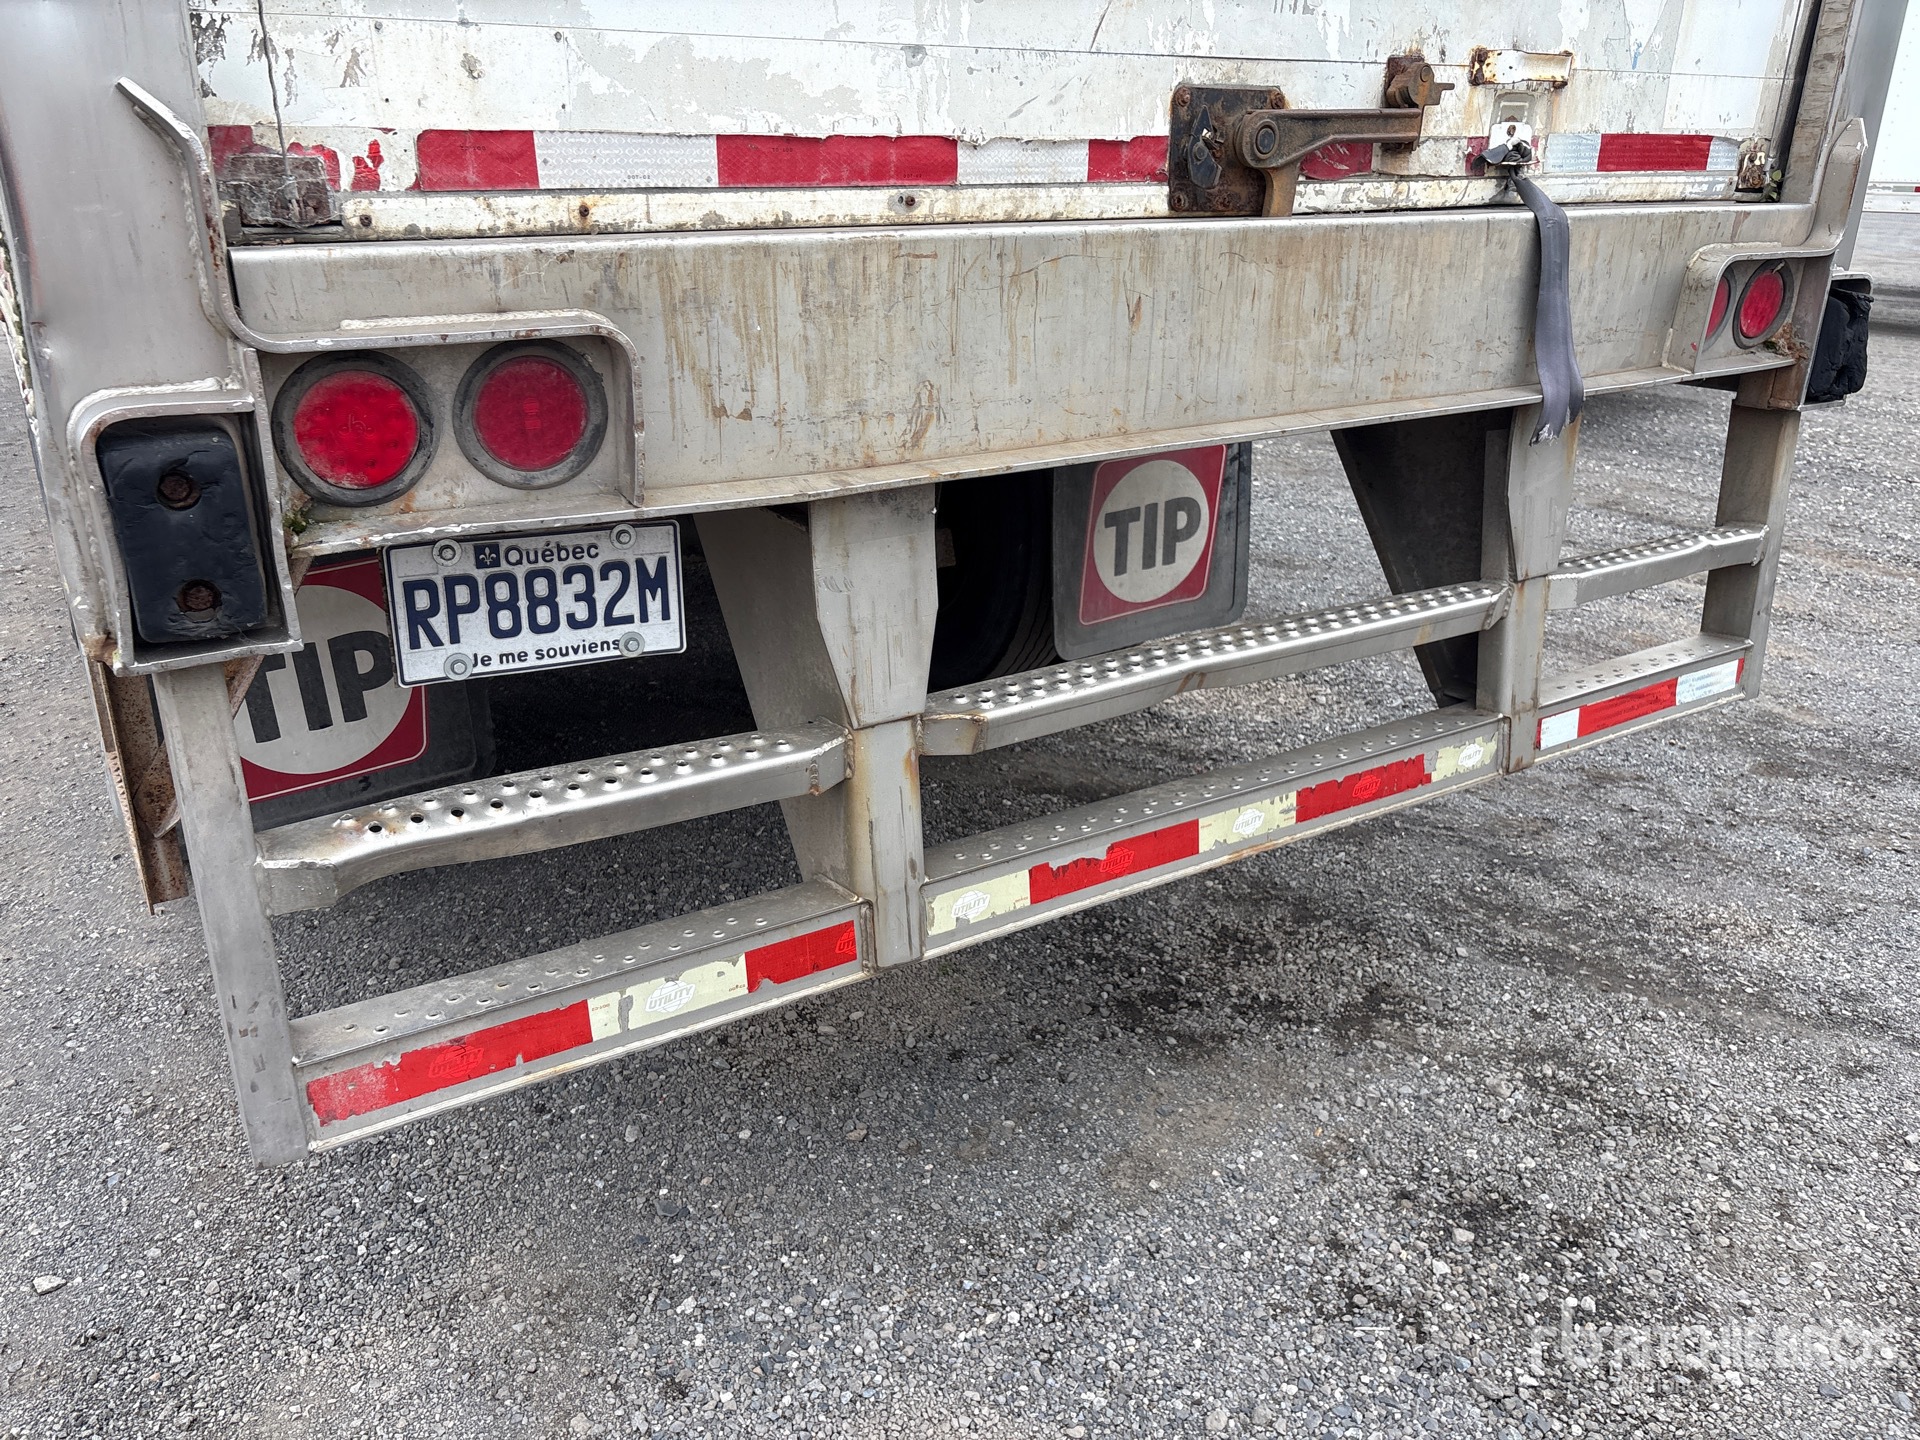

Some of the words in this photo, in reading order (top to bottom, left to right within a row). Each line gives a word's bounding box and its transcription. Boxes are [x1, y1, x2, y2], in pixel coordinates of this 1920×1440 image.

[1104, 496, 1202, 577] TIP
[504, 541, 600, 568] Québec
[402, 555, 671, 651] RP8832M
[469, 652, 493, 668] Je
[499, 651, 529, 666] me
[535, 638, 621, 664] souviens
[244, 629, 395, 744] TIP
[1234, 813, 1263, 831] UTILITY
[1101, 851, 1133, 871] UTILITY
[953, 895, 989, 917] UTILITY
[648, 985, 694, 1010] UTILITY
